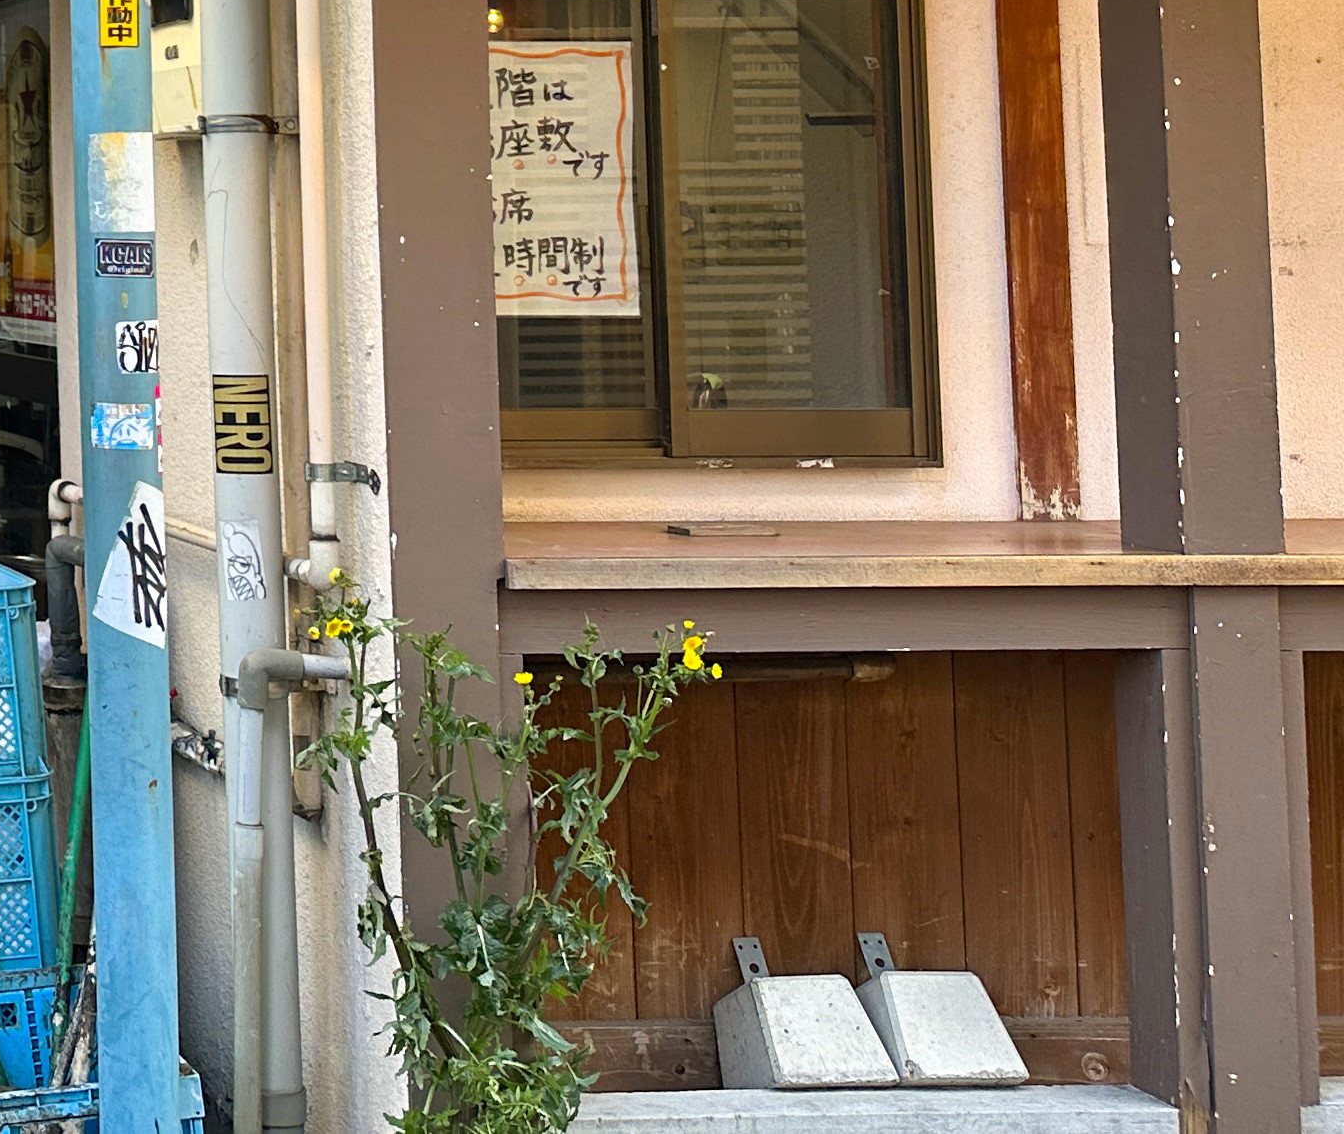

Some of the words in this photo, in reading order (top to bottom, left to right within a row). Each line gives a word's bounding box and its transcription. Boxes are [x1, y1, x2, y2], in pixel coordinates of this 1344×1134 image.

[489, 67, 574, 109] 階は
[490, 116, 577, 160] 座敷
[563, 150, 610, 180] です
[492, 188, 534, 225] 席
[494, 236, 605, 277] 時間制
[563, 276, 606, 298] です
[213, 375, 272, 473] NERO
